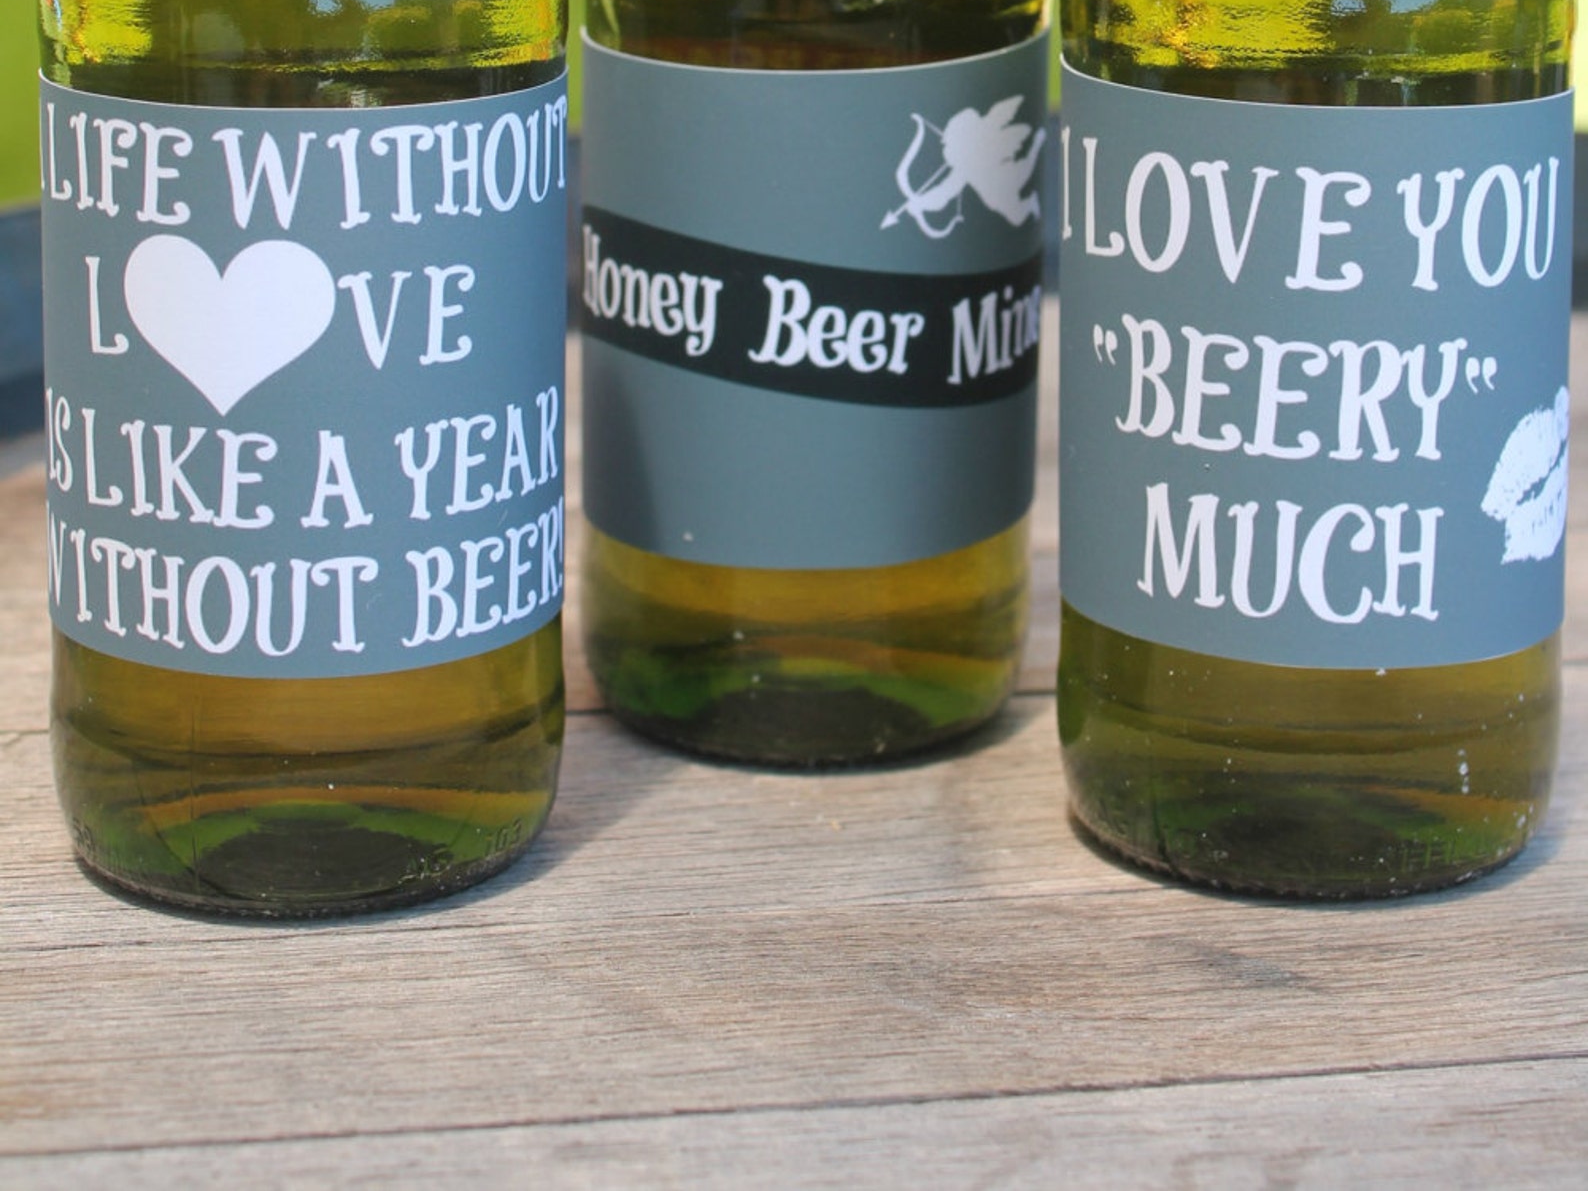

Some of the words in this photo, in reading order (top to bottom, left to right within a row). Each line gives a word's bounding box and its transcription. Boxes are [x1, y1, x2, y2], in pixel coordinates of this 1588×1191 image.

[47, 102, 193, 225] LIFE
[212, 95, 567, 230] WITHOUT
[1062, 126, 1072, 239] I
[1083, 137, 1372, 291] LOVE
[1398, 157, 1560, 291] YOU
[582, 224, 723, 356] Honey
[748, 275, 924, 374] Beer
[82, 407, 277, 529] LIKE
[300, 429, 373, 528] A
[394, 385, 559, 520] YEAR
[1137, 482, 1445, 625] MUCH
